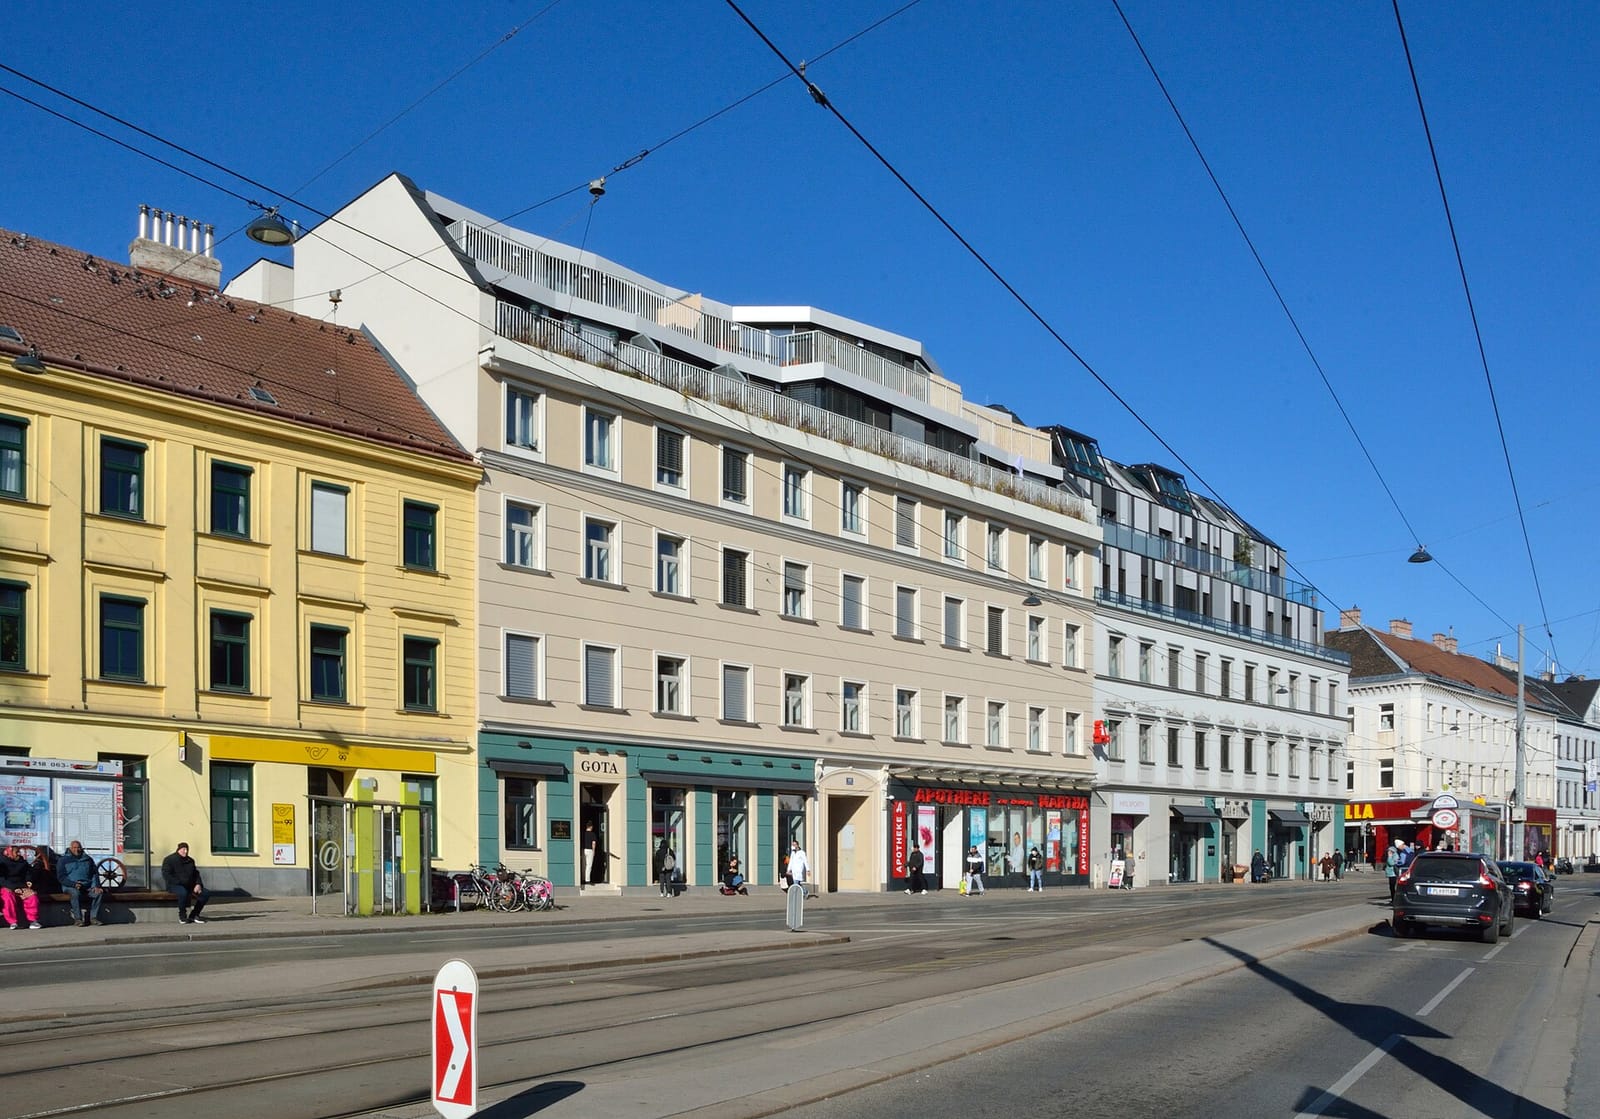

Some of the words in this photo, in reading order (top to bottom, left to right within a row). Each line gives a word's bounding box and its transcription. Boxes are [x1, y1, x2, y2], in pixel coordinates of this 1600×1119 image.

[581, 760, 618, 774] GOTA
[914, 787, 990, 806] APOTHEKE
[1038, 795, 1089, 810] MARTHA
[895, 816, 903, 873] APOTHEKE
